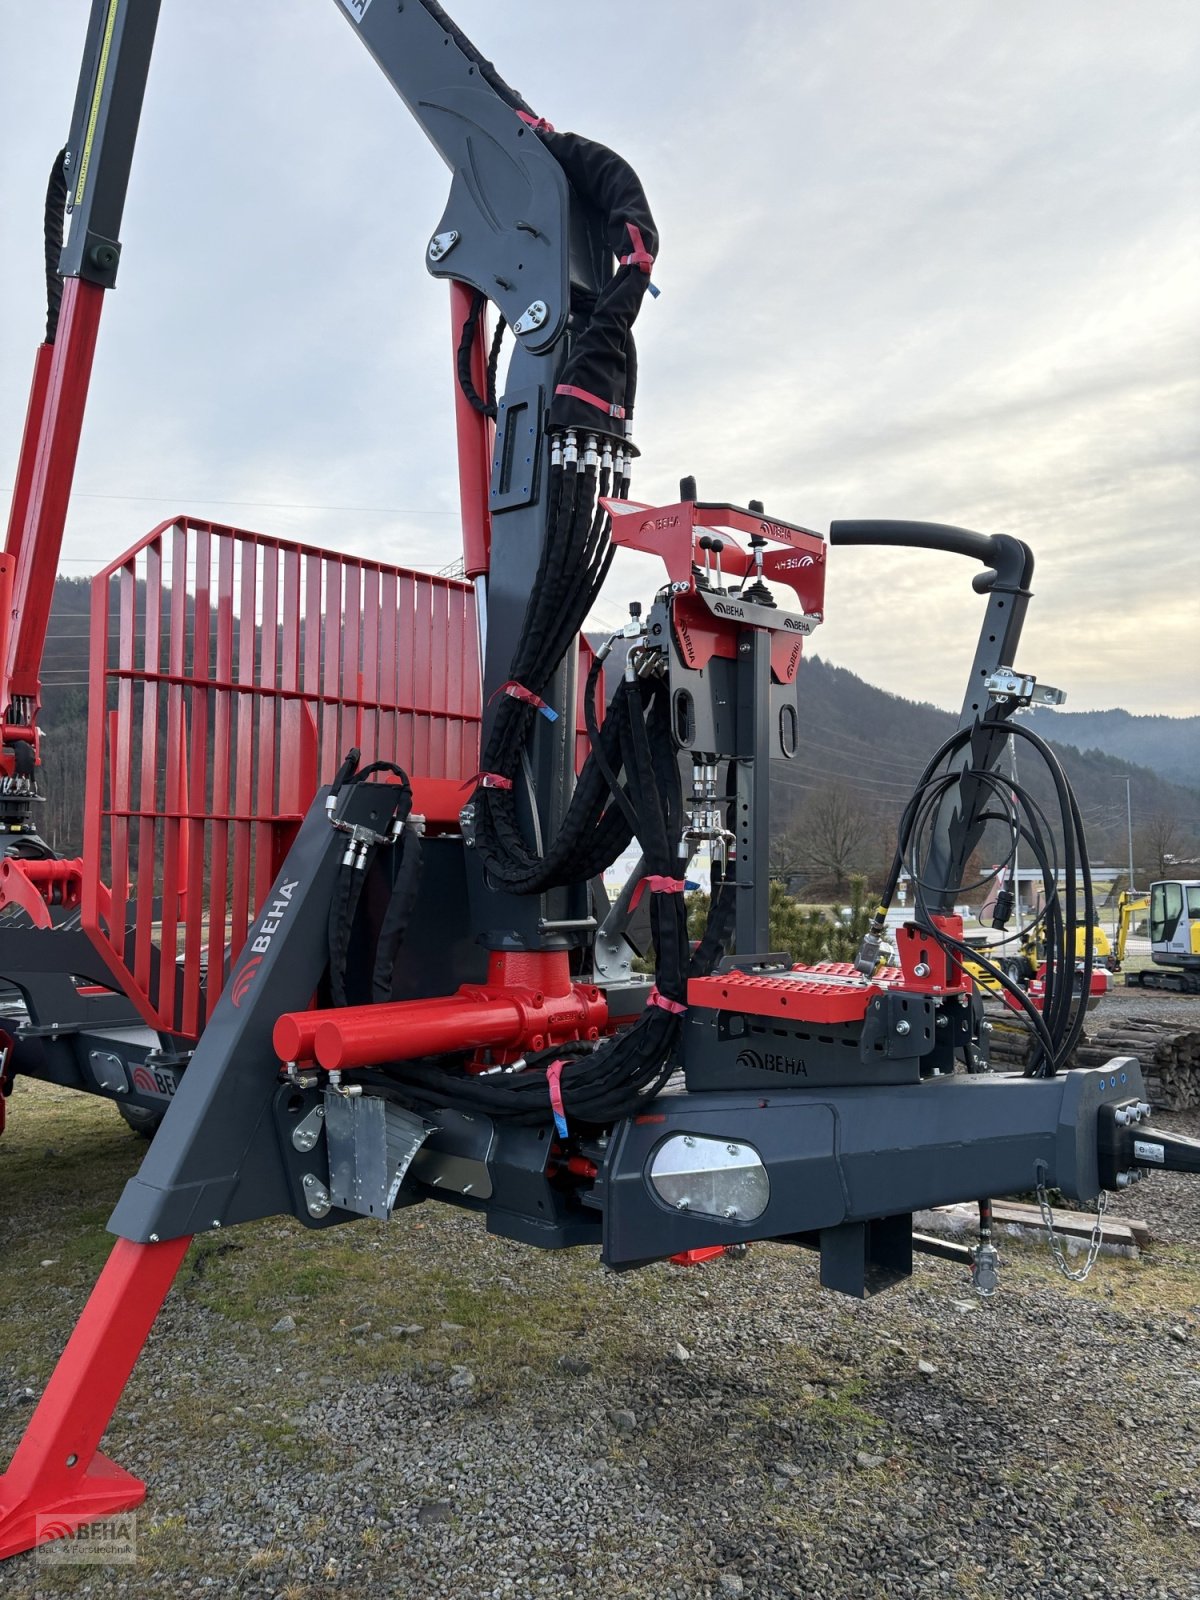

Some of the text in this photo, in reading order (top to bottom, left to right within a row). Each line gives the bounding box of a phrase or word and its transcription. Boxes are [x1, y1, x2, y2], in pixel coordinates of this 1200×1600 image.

[654, 515, 681, 531] BEHA
[772, 525, 792, 541] BEHA
[725, 604, 745, 618] BEHA
[794, 620, 811, 633] BEHA
[684, 632, 696, 664] BEHA
[790, 641, 801, 668] BEHA
[251, 880, 299, 953] BEHA
[764, 1053, 808, 1077] BEHA
[154, 1072, 178, 1096] BE
